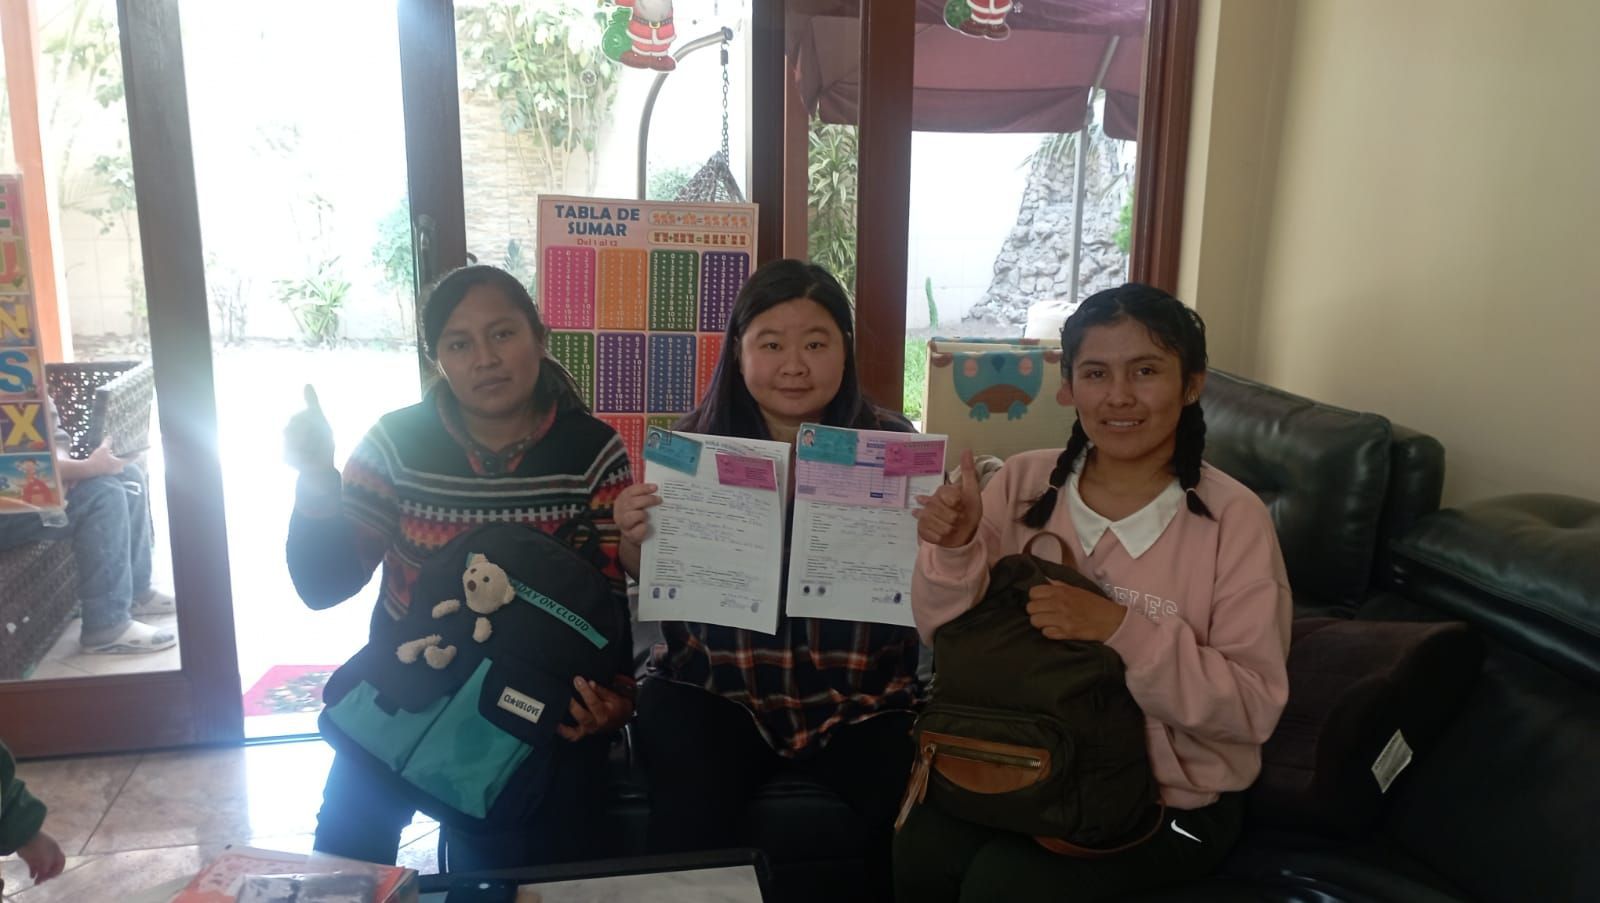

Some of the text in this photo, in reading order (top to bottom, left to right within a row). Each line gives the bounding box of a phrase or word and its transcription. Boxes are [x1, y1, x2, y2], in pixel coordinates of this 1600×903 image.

[555, 205, 640, 221] TABLA DE
[568, 222, 627, 236] SUMAR
[0, 350, 33, 393] S
[3, 404, 44, 446] X
[519, 584, 589, 631] DAY ON CLOUD
